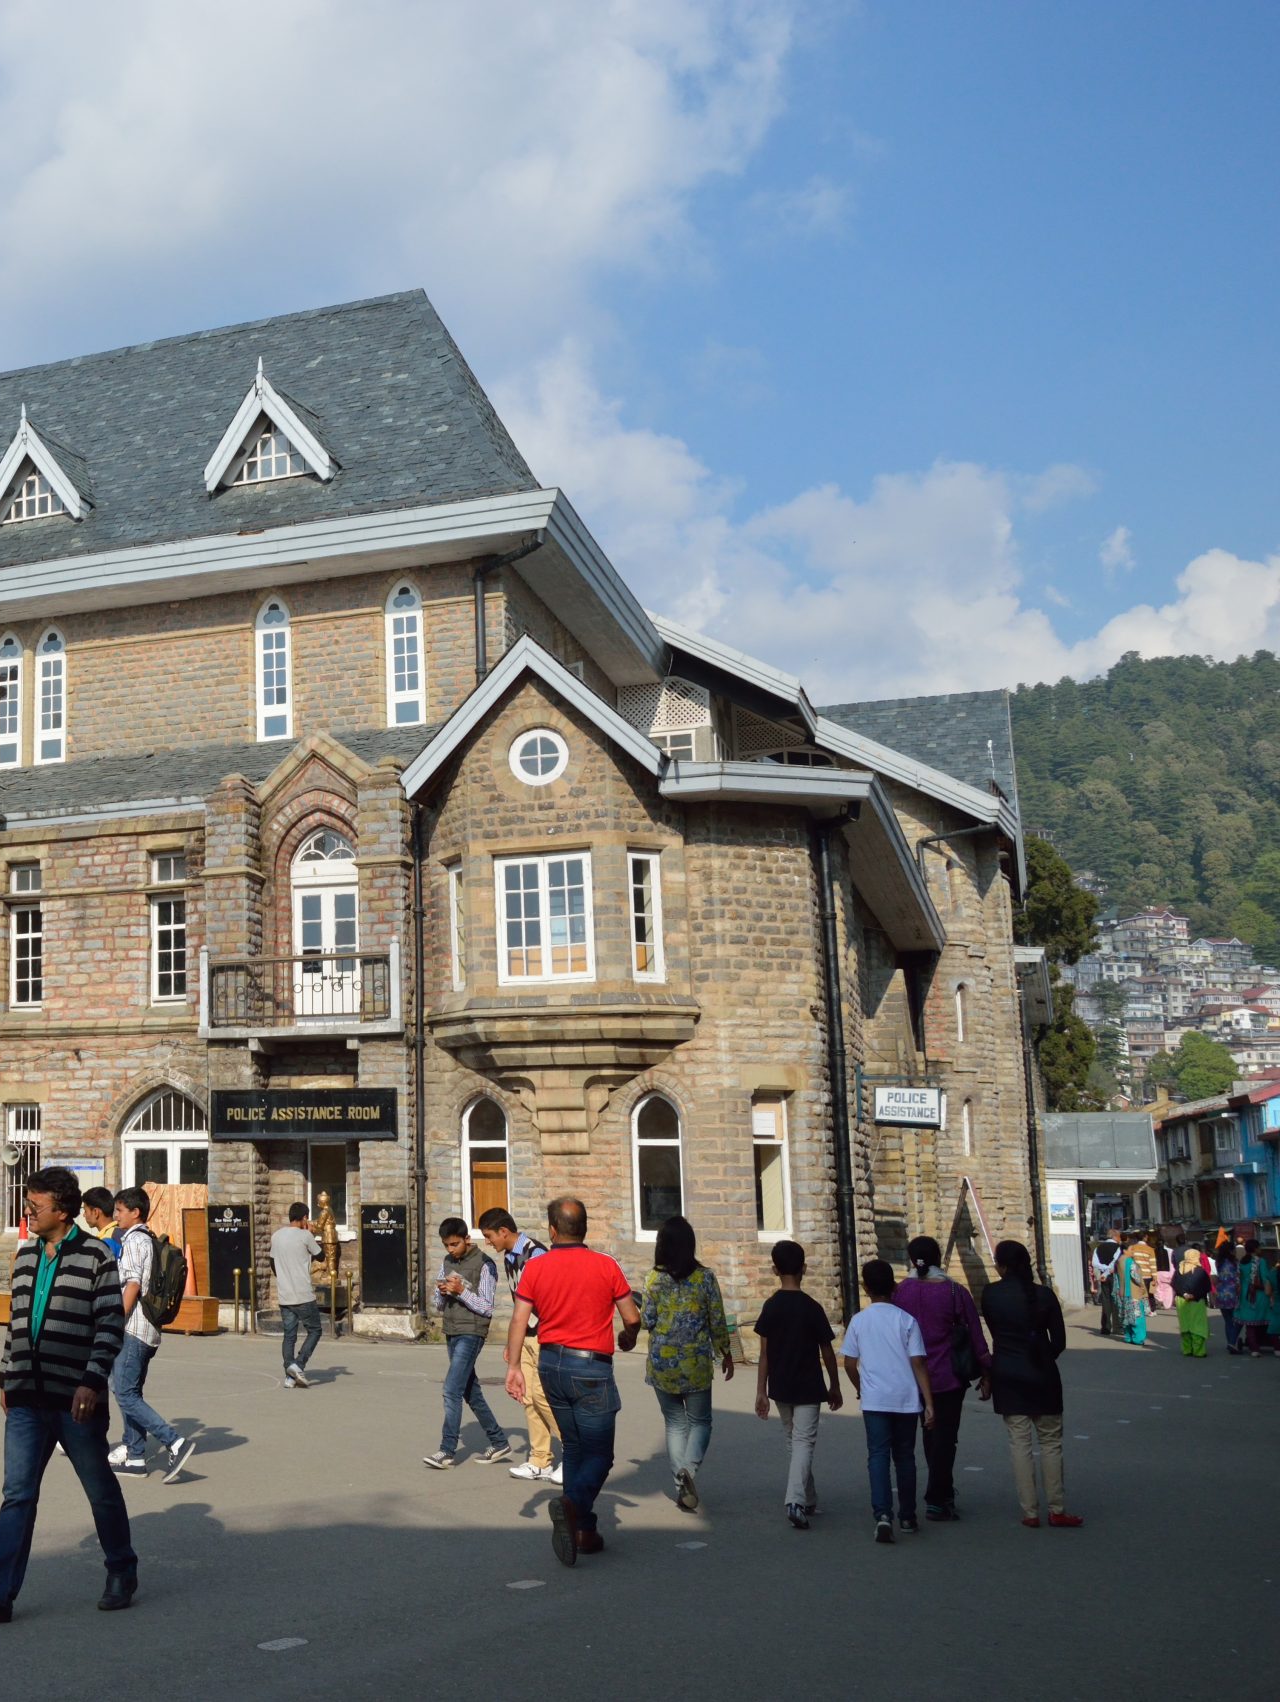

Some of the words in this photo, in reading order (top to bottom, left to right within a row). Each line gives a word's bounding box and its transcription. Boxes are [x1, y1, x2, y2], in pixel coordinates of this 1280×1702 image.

[887, 1092, 928, 1104] POLICE
[226, 1107, 266, 1121] POLICE
[271, 1106, 343, 1120] ASSISTANCE
[348, 1105, 380, 1120] ROOM
[878, 1105, 937, 1119] ASSISTANCE
